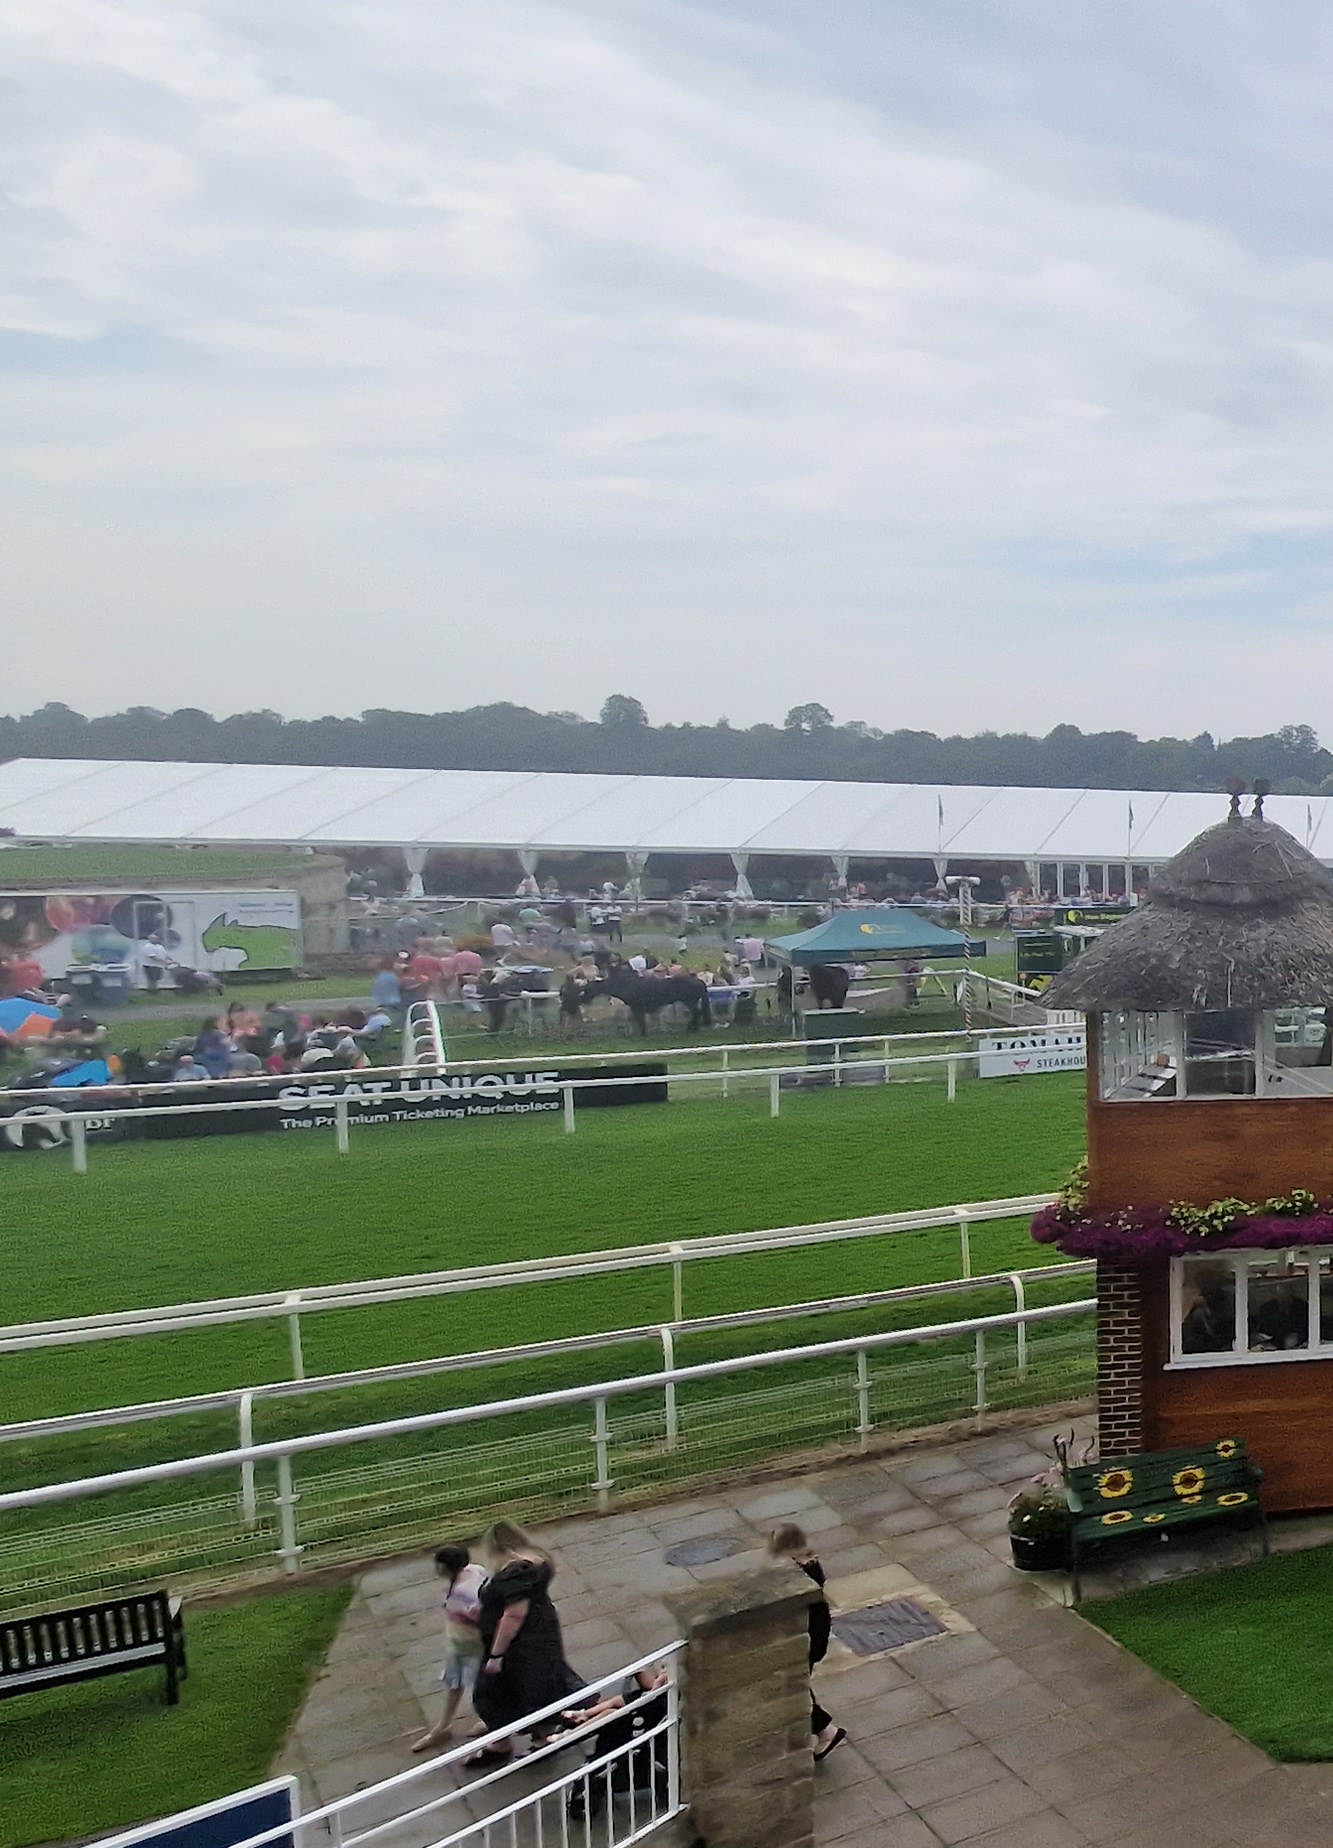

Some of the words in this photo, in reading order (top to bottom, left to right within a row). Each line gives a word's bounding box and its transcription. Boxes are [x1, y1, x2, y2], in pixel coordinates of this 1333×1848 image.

[279, 1081, 393, 1111] SEAT
[400, 1071, 560, 1103] UNIQUE
[280, 1117, 313, 1129] The
[315, 1112, 389, 1127] Prmium
[391, 1106, 465, 1121] Ticketing
[467, 1101, 560, 1116] Marketplace
